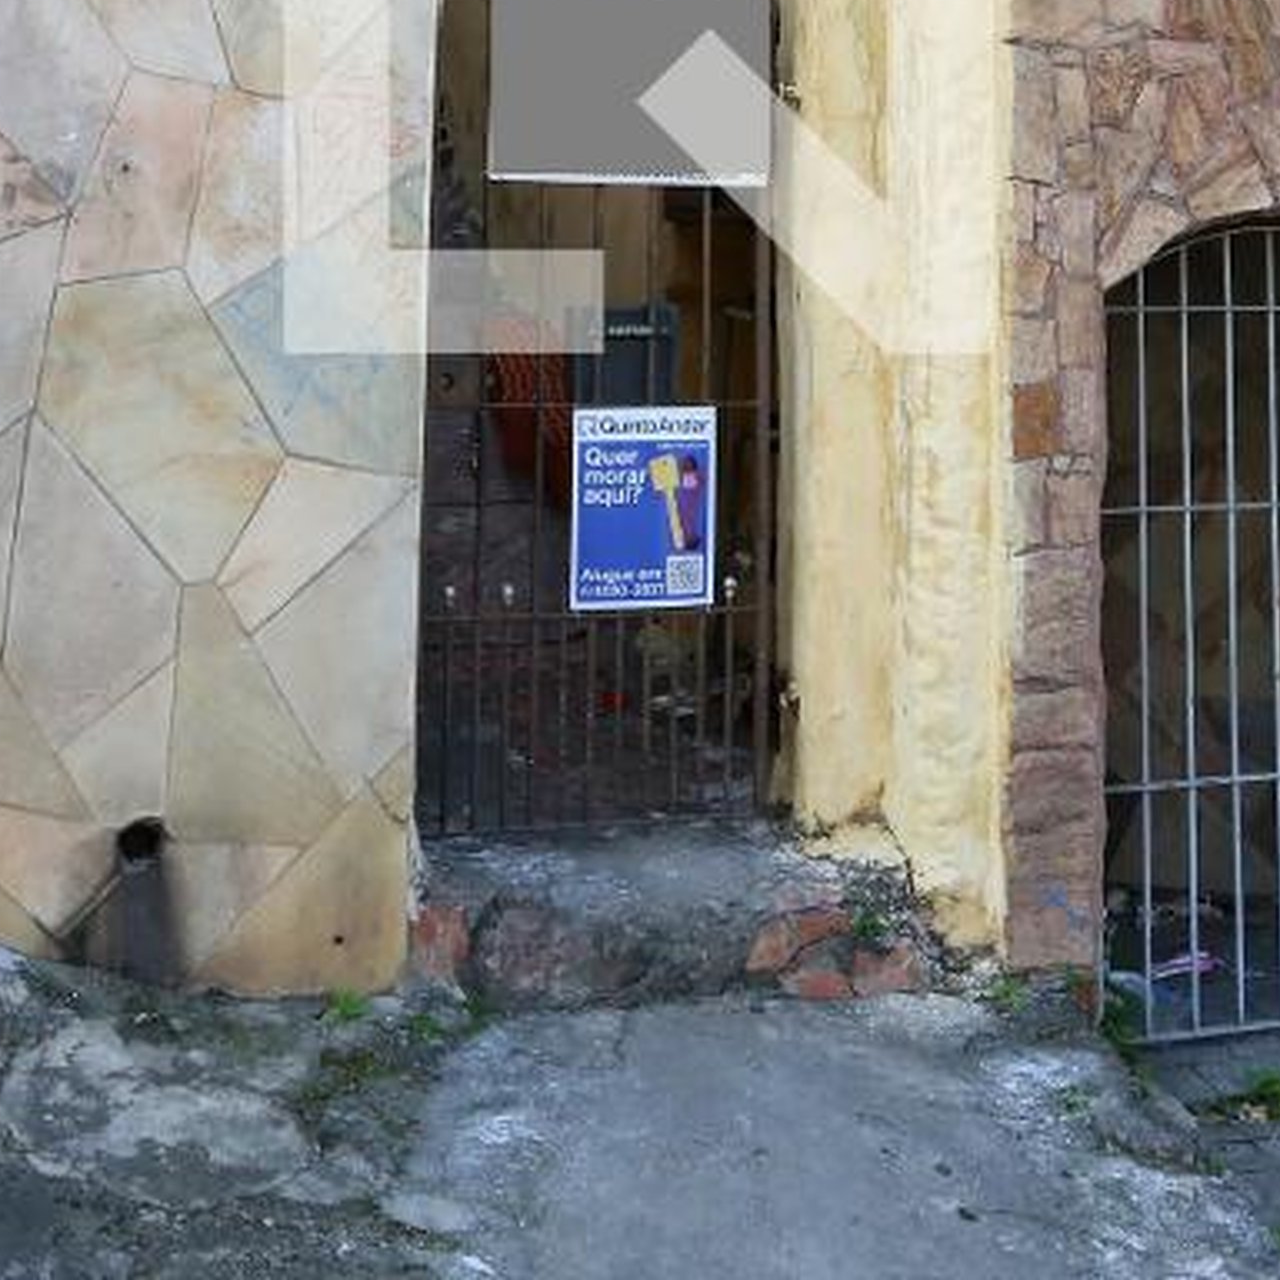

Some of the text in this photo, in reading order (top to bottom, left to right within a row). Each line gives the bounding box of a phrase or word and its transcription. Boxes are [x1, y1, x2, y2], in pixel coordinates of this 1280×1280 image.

[584, 447, 639, 467] Quer
[583, 470, 645, 486] morar
[583, 486, 644, 508] aqui?
